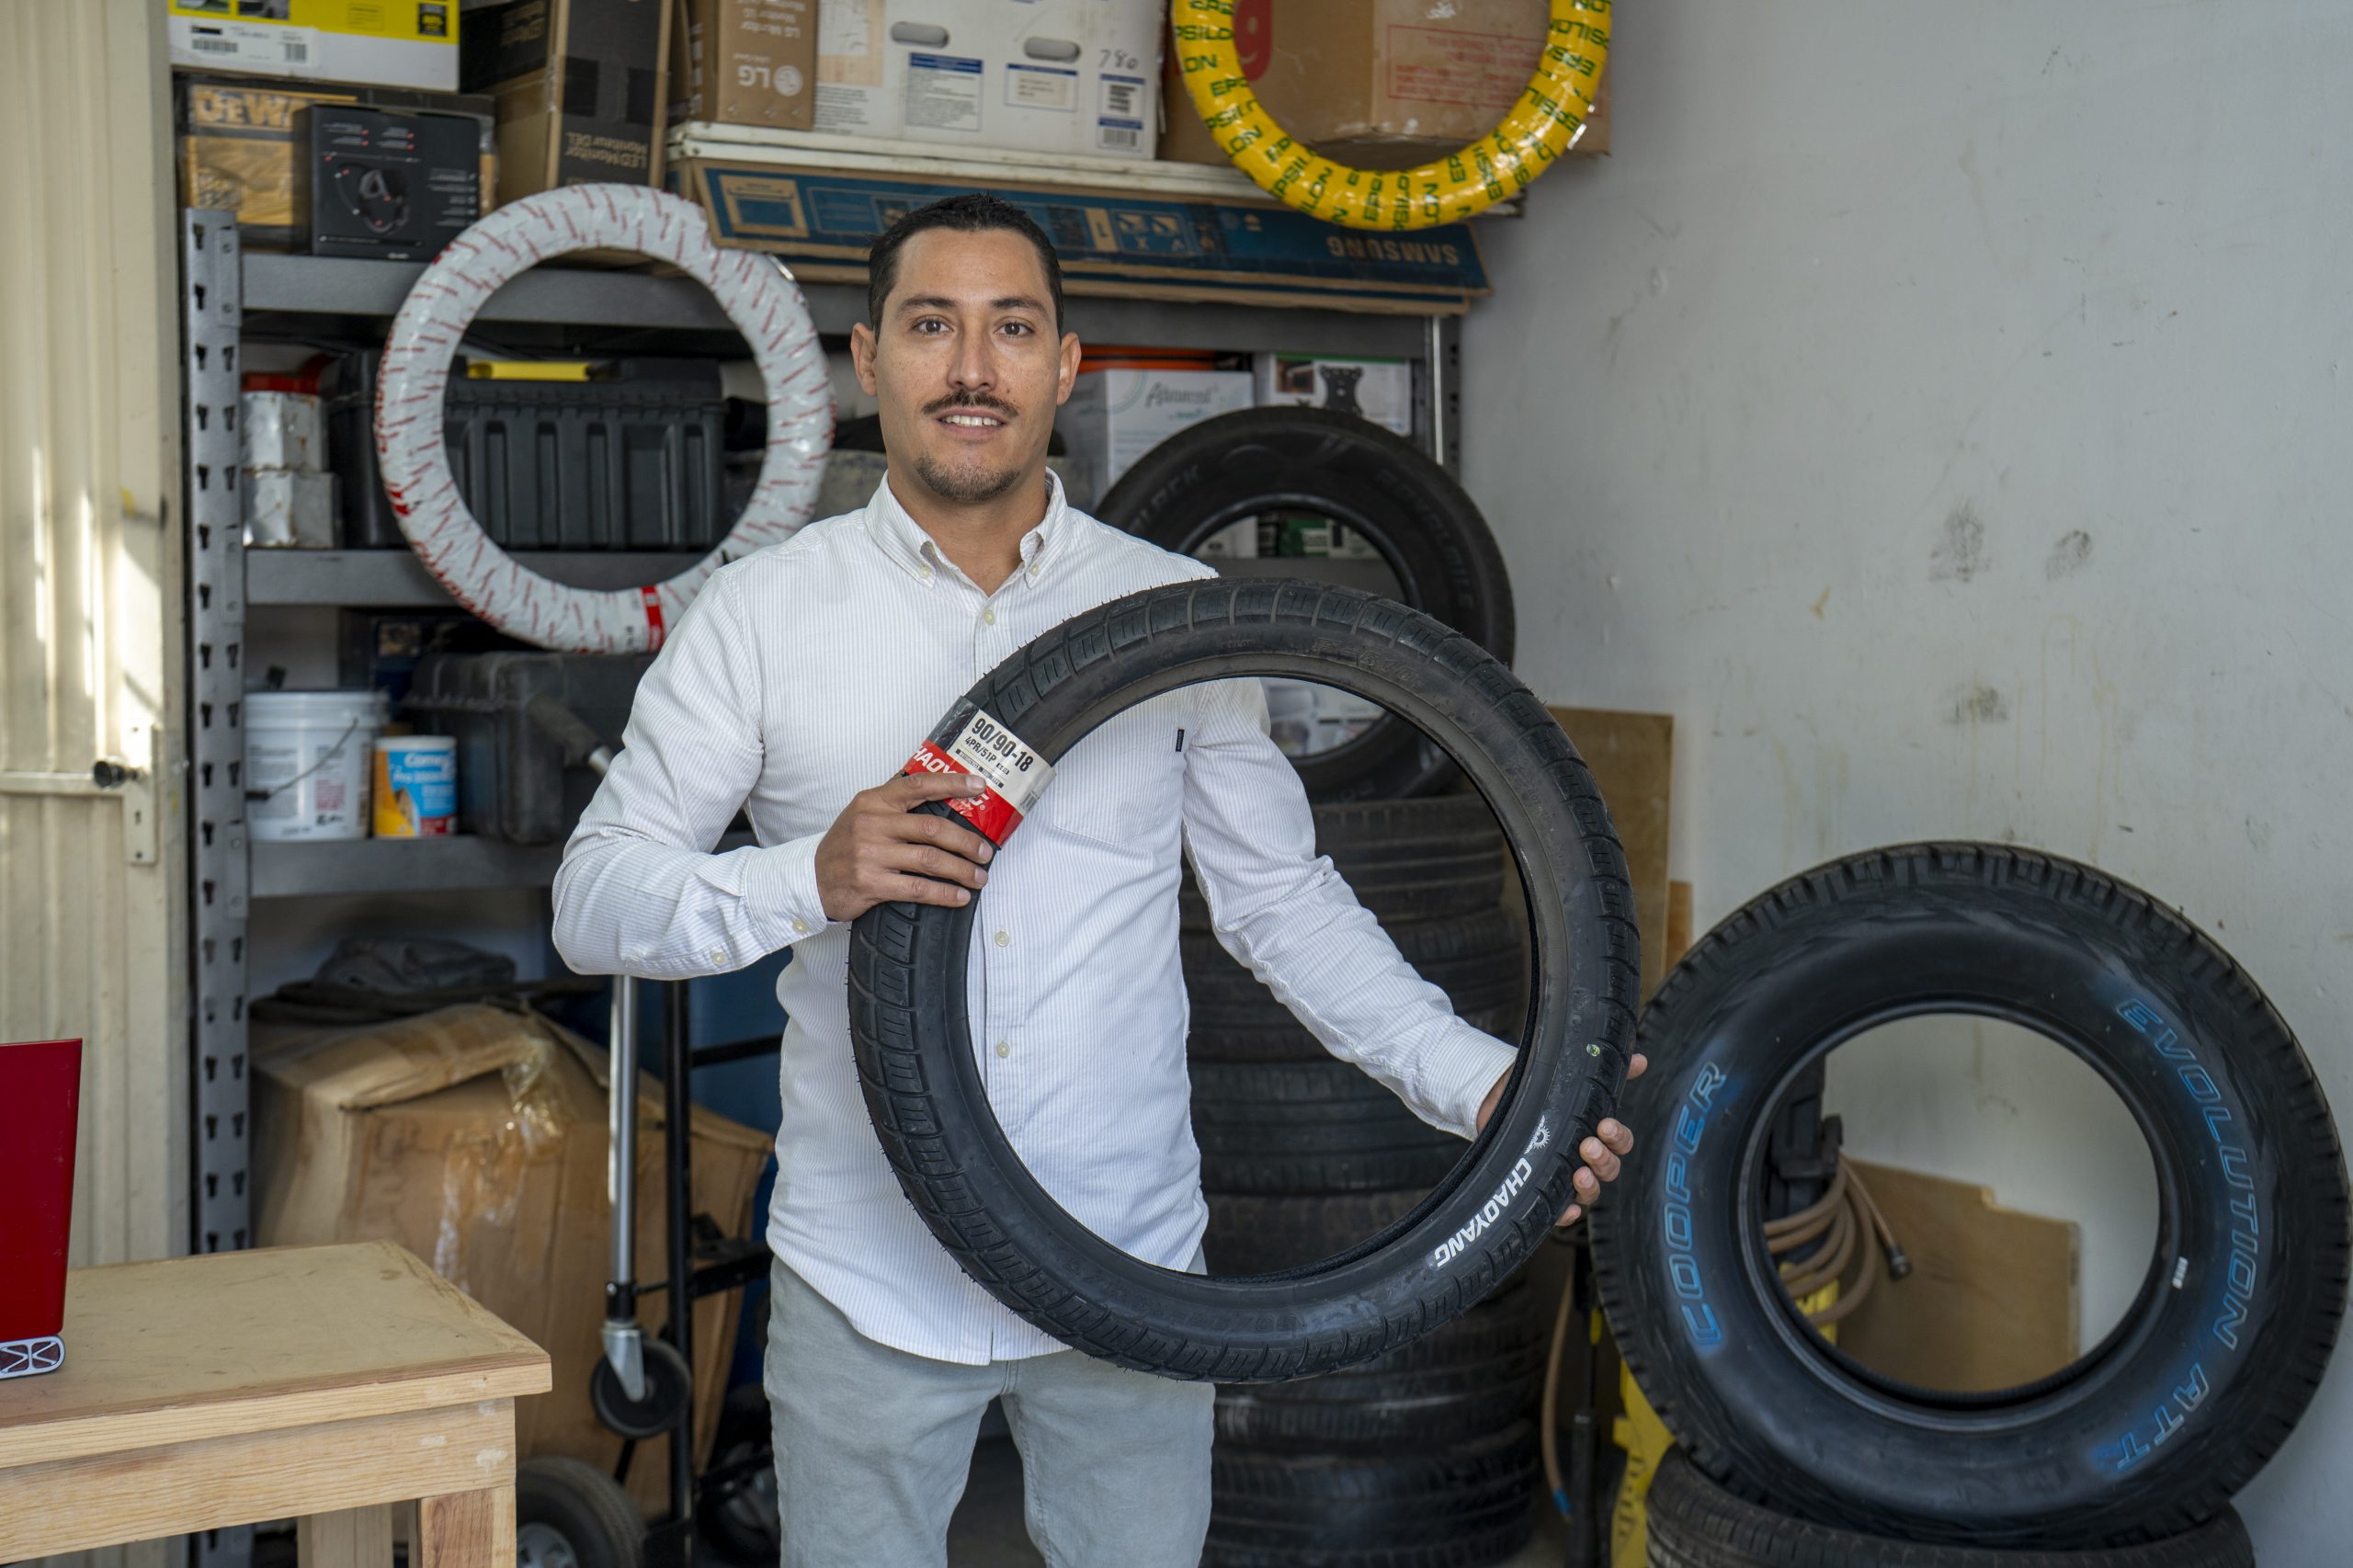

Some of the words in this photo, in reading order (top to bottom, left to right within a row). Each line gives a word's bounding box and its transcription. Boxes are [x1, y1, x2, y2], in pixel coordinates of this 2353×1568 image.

[738, 64, 771, 88] LG
[1326, 236, 1461, 267] SAMSUNG
[965, 736, 997, 762] 4PR/51P
[972, 717, 1034, 772] 90/90-18
[1434, 1157, 1532, 1267] CHAOYANG
[1663, 1059, 1727, 1349] COOPER
[2117, 996, 2259, 1351] EVOLUTION
[2117, 1361, 2210, 1471] ATT
